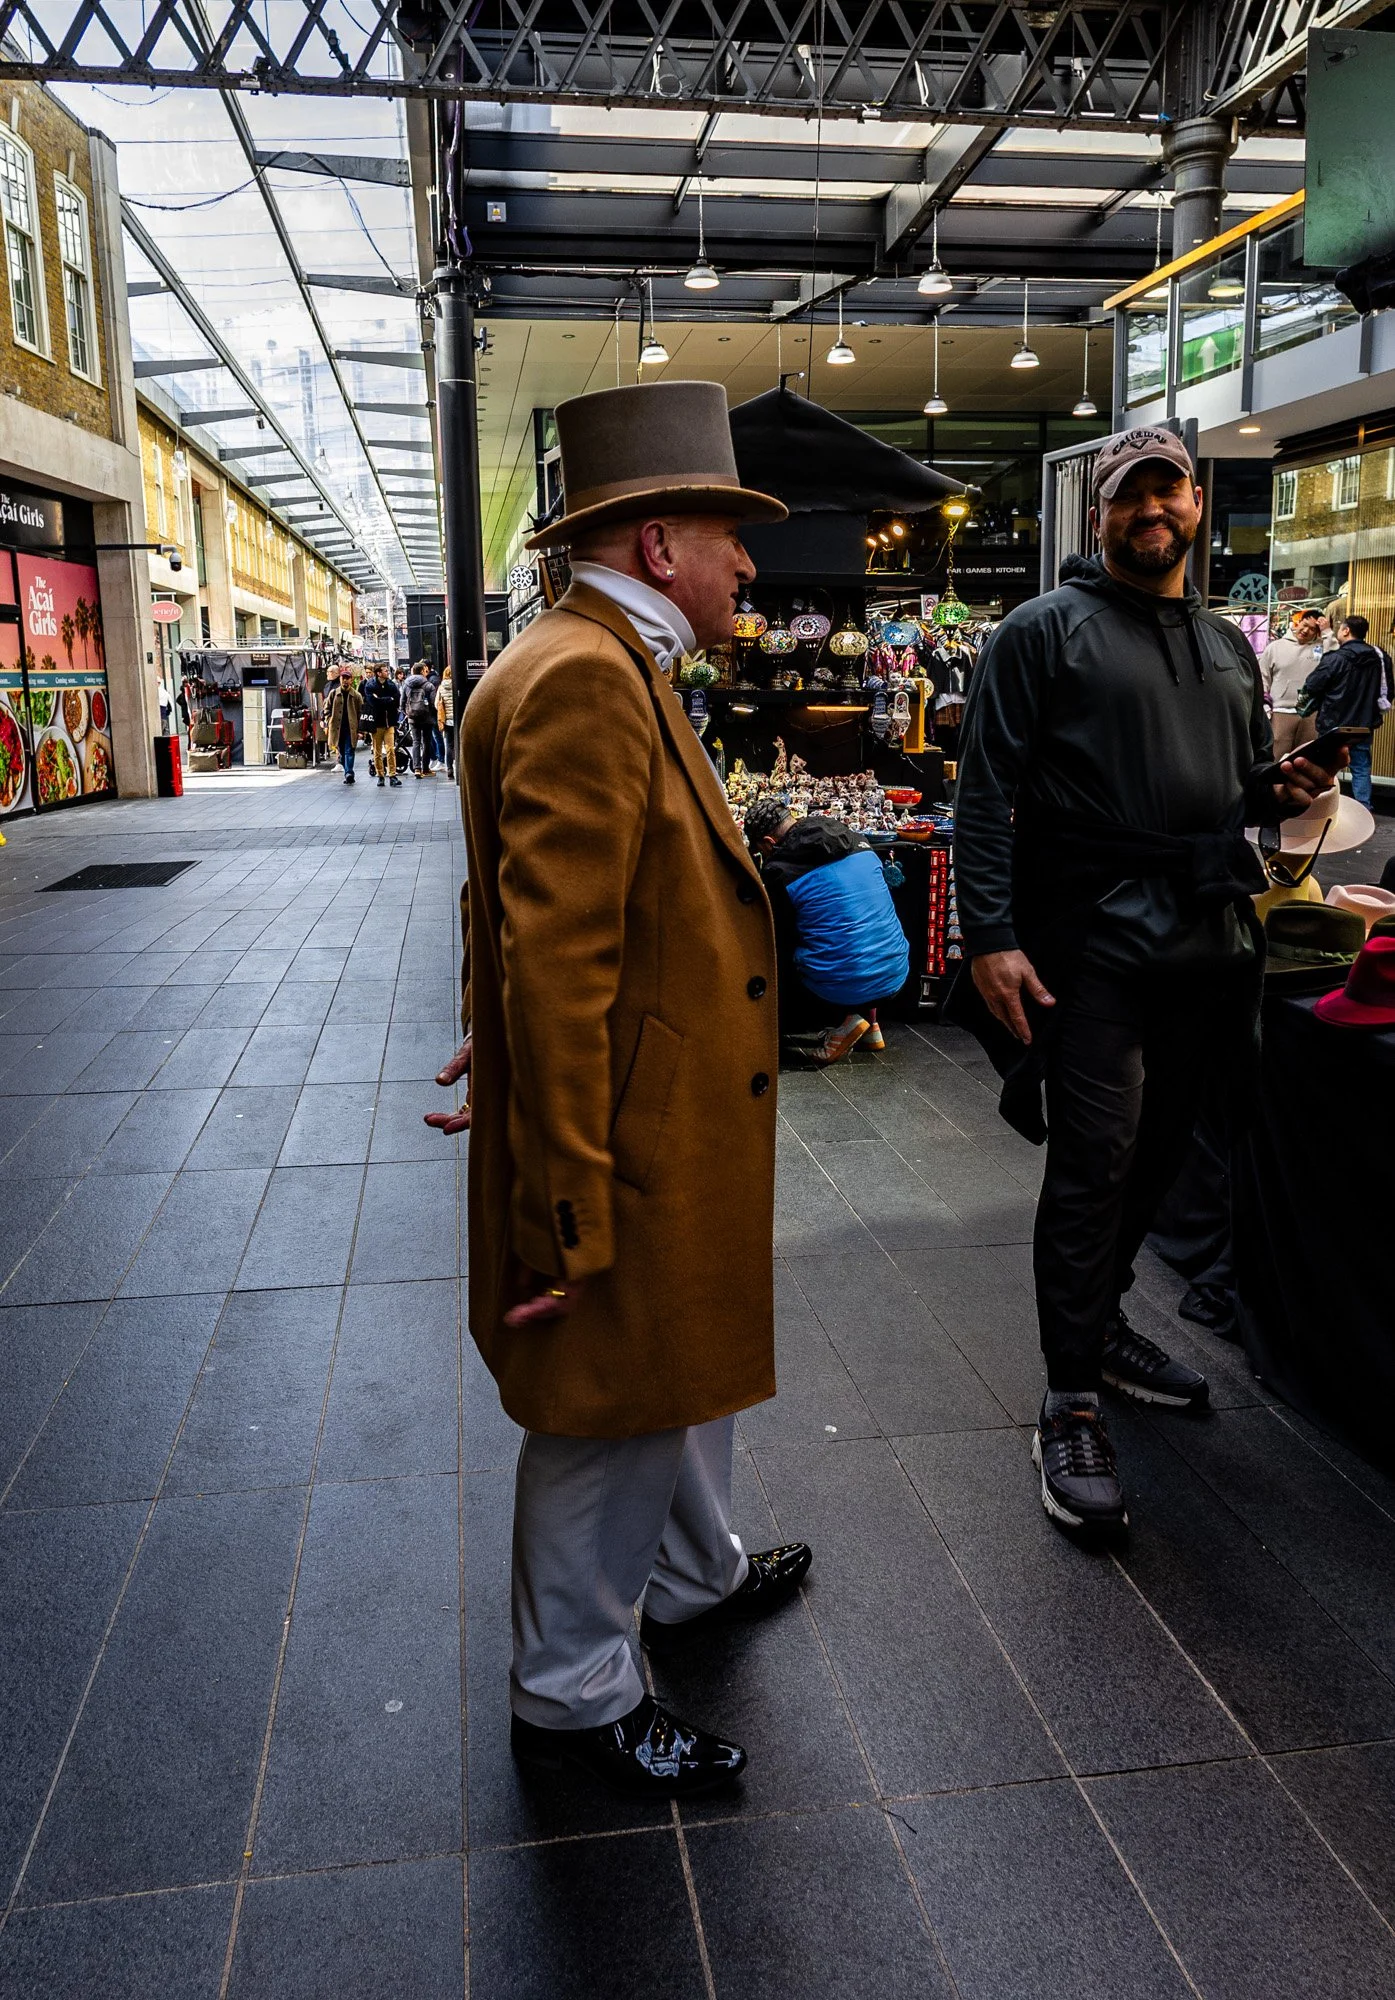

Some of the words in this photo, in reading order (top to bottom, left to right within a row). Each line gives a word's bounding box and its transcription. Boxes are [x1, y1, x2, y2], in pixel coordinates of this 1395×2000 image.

[1, 493, 10, 504] The
[0, 503, 18, 524] çaí
[19, 504, 45, 528] Girls
[35, 576, 46, 588] The
[29, 611, 57, 636] Girls
